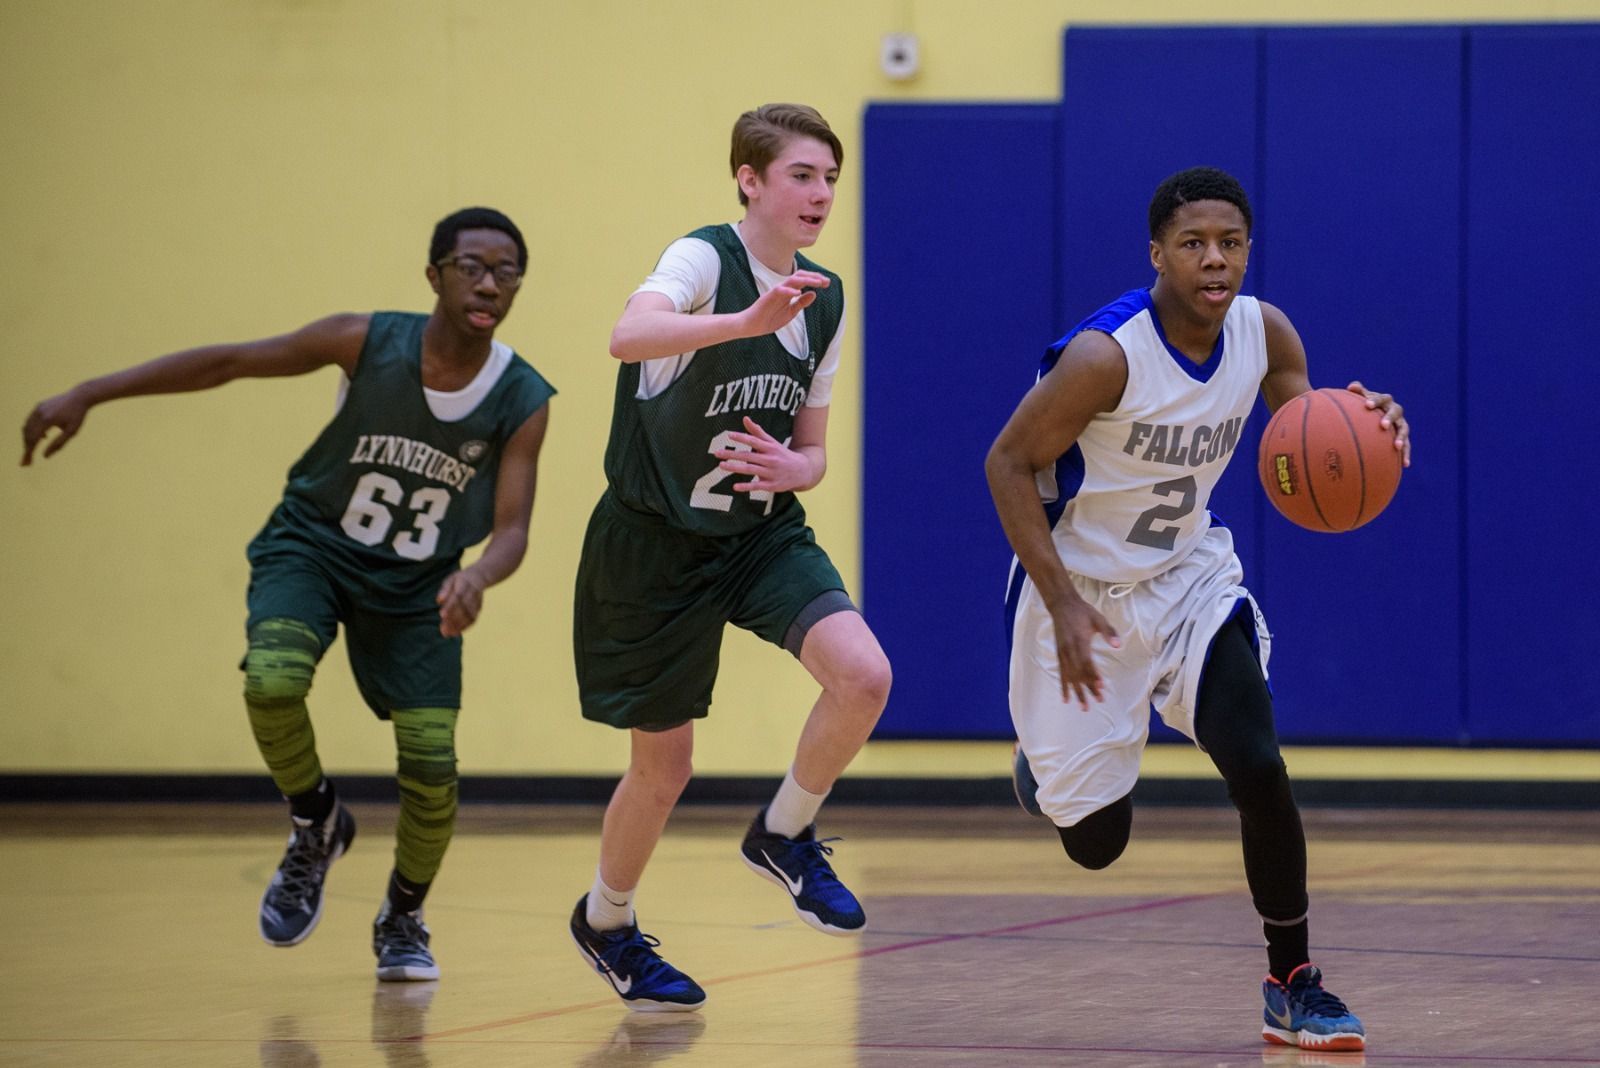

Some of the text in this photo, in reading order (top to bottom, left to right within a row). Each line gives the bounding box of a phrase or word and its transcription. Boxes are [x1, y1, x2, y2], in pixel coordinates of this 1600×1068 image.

[349, 434, 477, 493] LYNNHURST
[1123, 416, 1242, 467] FALCON
[340, 471, 452, 561] 63
[1125, 475, 1198, 551] 2
